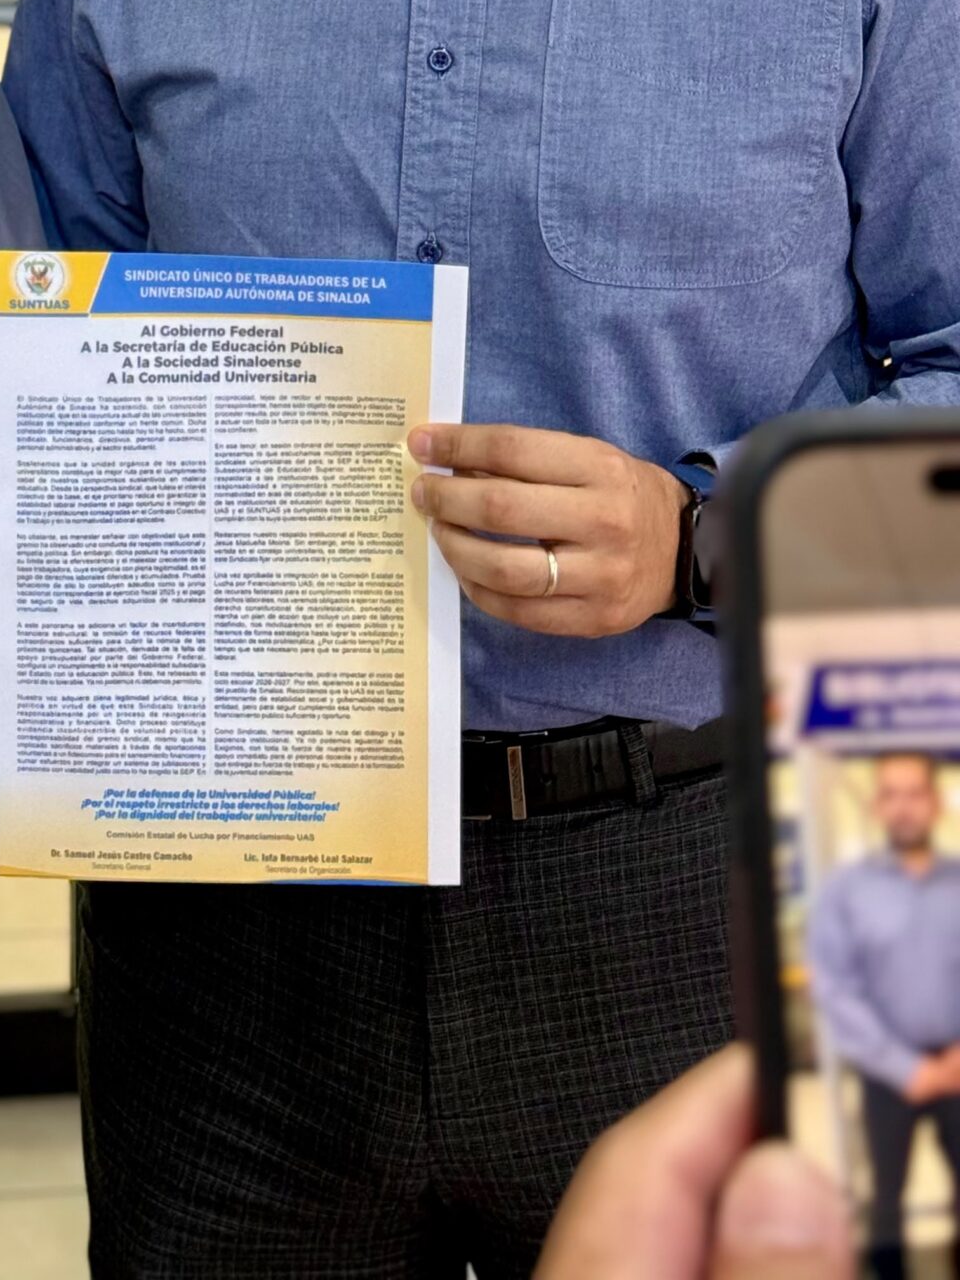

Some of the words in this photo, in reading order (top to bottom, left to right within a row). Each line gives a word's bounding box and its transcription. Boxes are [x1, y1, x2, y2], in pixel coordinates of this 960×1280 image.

[125, 271, 189, 282] SINDICATO
[193, 271, 232, 282] ÚNICO
[235, 273, 250, 283] DE
[255, 275, 348, 287] TRABAJADORES
[352, 276, 367, 287] DE
[371, 277, 385, 288] LA
[140, 288, 222, 299] UNIVERSIDAD
[225, 288, 294, 300] AUTÓNOMA
[298, 291, 314, 301] DE
[317, 292, 369, 303] SINALOA
[9, 299, 70, 309] SUNTUAS
[140, 324, 156, 336] Al
[159, 324, 225, 337] Gobierno
[229, 325, 283, 338] Federal
[80, 341, 91, 352] A
[95, 340, 108, 352] la
[112, 339, 186, 353] Secretaría
[188, 340, 207, 353] de
[210, 340, 286, 353] Educación
[289, 341, 343, 354] Pública
[122, 356, 132, 368] A
[136, 356, 150, 367] la
[153, 355, 219, 368] Sociedad
[223, 355, 301, 368] Sinaloense
[106, 372, 117, 383] A
[121, 371, 134, 383] la
[138, 370, 221, 383] Comunidad
[224, 370, 316, 382] Universitaria
[103, 788, 124, 800] ¡Por
[126, 788, 136, 797] la
[138, 788, 180, 799] defensa
[181, 789, 194, 799] de
[196, 789, 206, 799] la
[208, 789, 272, 799] Universidad
[272, 789, 315, 800] Pública!
[81, 798, 101, 810] ¡Por
[104, 799, 114, 807] el
[211, 802, 218, 810] a
[220, 800, 236, 811] los
[237, 800, 285, 811] derechos
[286, 801, 339, 811] laborales!
[94, 809, 115, 820] ¡Por
[117, 809, 128, 818] la
[129, 809, 176, 821] dignidad
[178, 810, 194, 819] del
[196, 810, 252, 822] trabajador
[255, 810, 325, 821] universitario!
